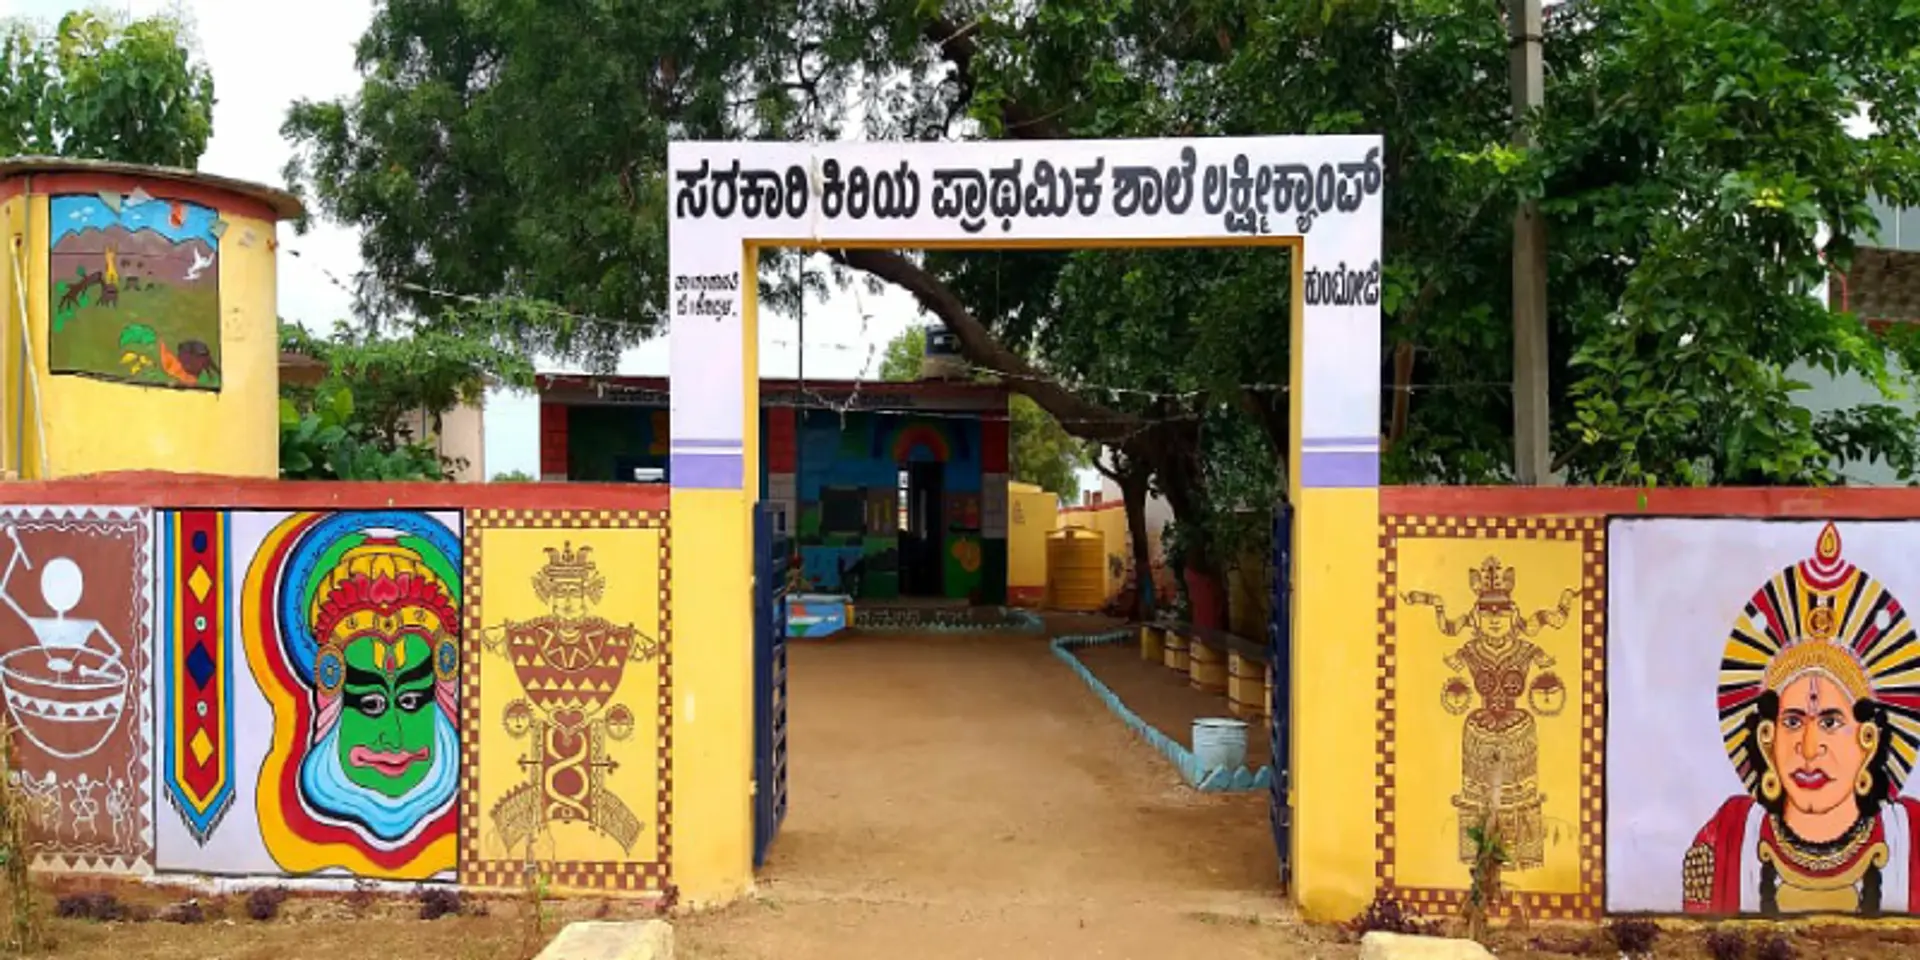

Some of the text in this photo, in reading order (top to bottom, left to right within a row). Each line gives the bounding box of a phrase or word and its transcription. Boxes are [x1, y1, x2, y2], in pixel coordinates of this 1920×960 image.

[675, 158, 809, 219] ಸರಕಾರಿ
[820, 158, 921, 220] ಕಿರಿಯ
[931, 157, 1105, 234] ಪ್ರಾಥಮಿಕ
[1111, 146, 1197, 218] ಶಾಲೆ
